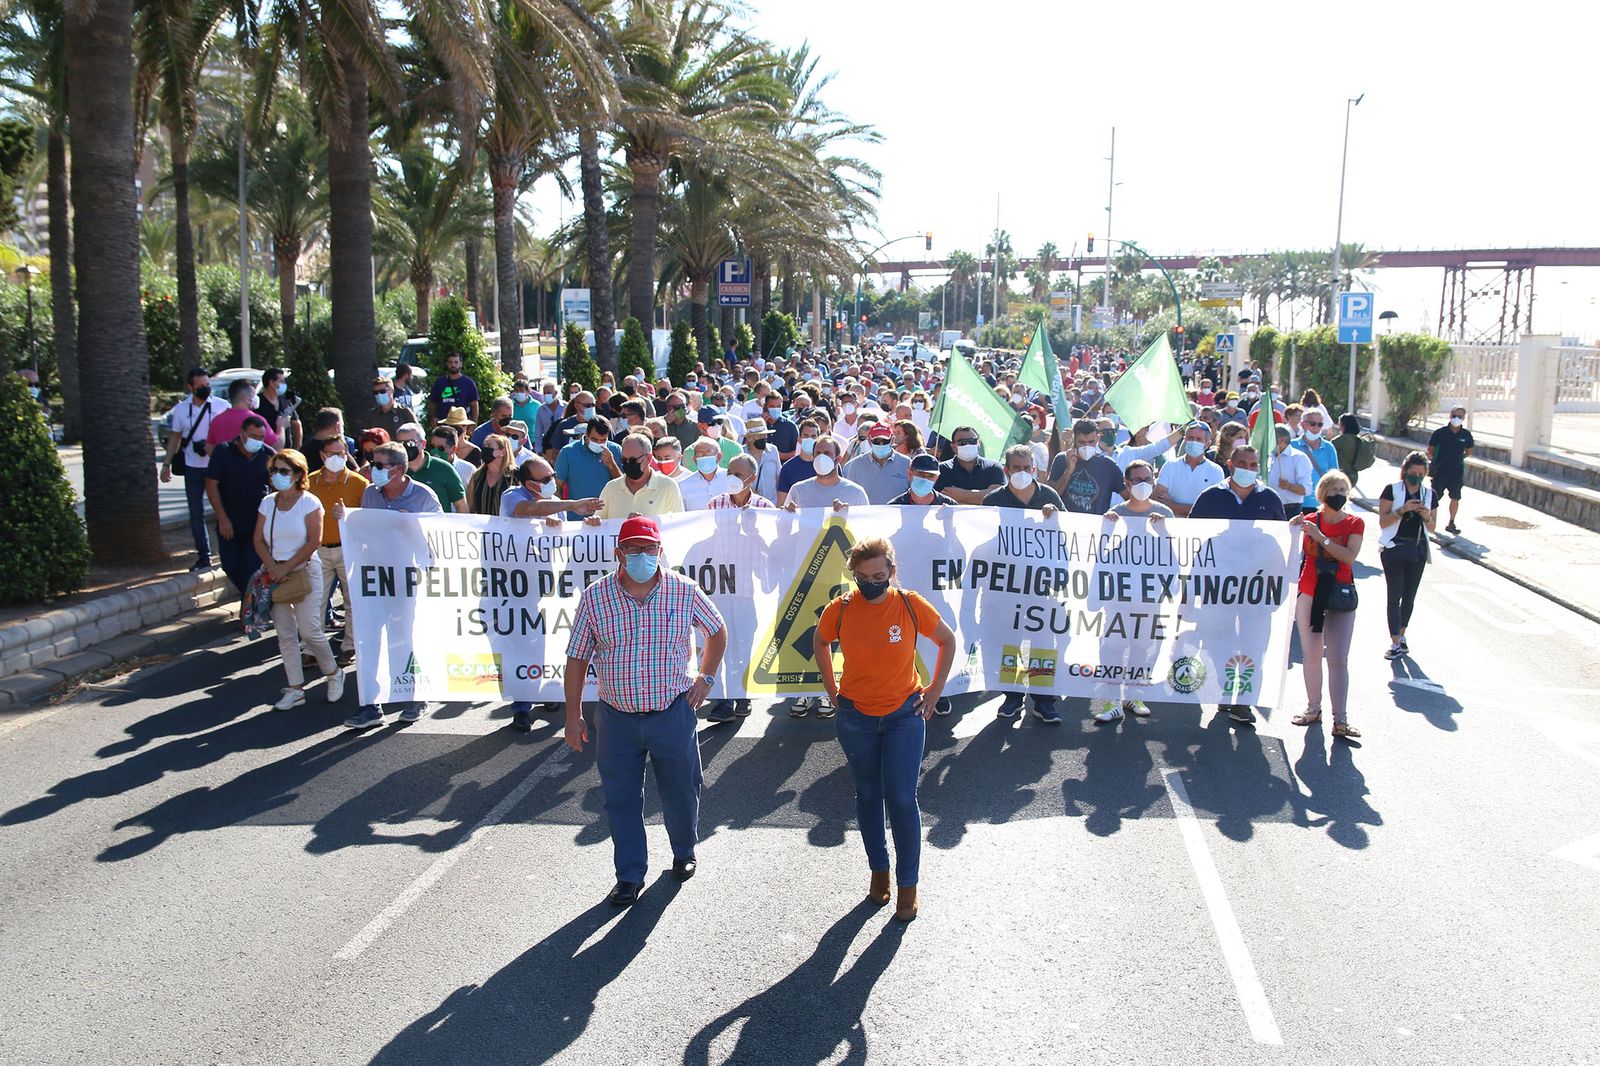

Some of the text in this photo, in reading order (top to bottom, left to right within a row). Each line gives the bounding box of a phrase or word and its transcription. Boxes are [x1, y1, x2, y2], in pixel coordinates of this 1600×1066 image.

[725, 261, 744, 283] P
[1347, 297, 1368, 318] P
[427, 530, 618, 563] NUESTRA AGRICULT
[808, 544, 830, 576] EUROPA
[997, 525, 1216, 568] NUESTRA AGRICULTURA
[361, 565, 396, 597] EN
[405, 565, 528, 598] PELIGRO
[538, 569, 574, 598] DE
[932, 559, 1284, 606] EN PELIGRO DE EXTINCIÓN
[456, 599, 578, 636] ¡SÚMA
[785, 592, 805, 621] COSTES
[1013, 601, 1183, 640] ¡SÚMATE!
[447, 663, 501, 676] COAG
[760, 637, 781, 670] PRECIOS
[777, 673, 803, 683] CRISIS
[1068, 663, 1153, 680] COEXPHAL
[1223, 681, 1253, 693] UPA
